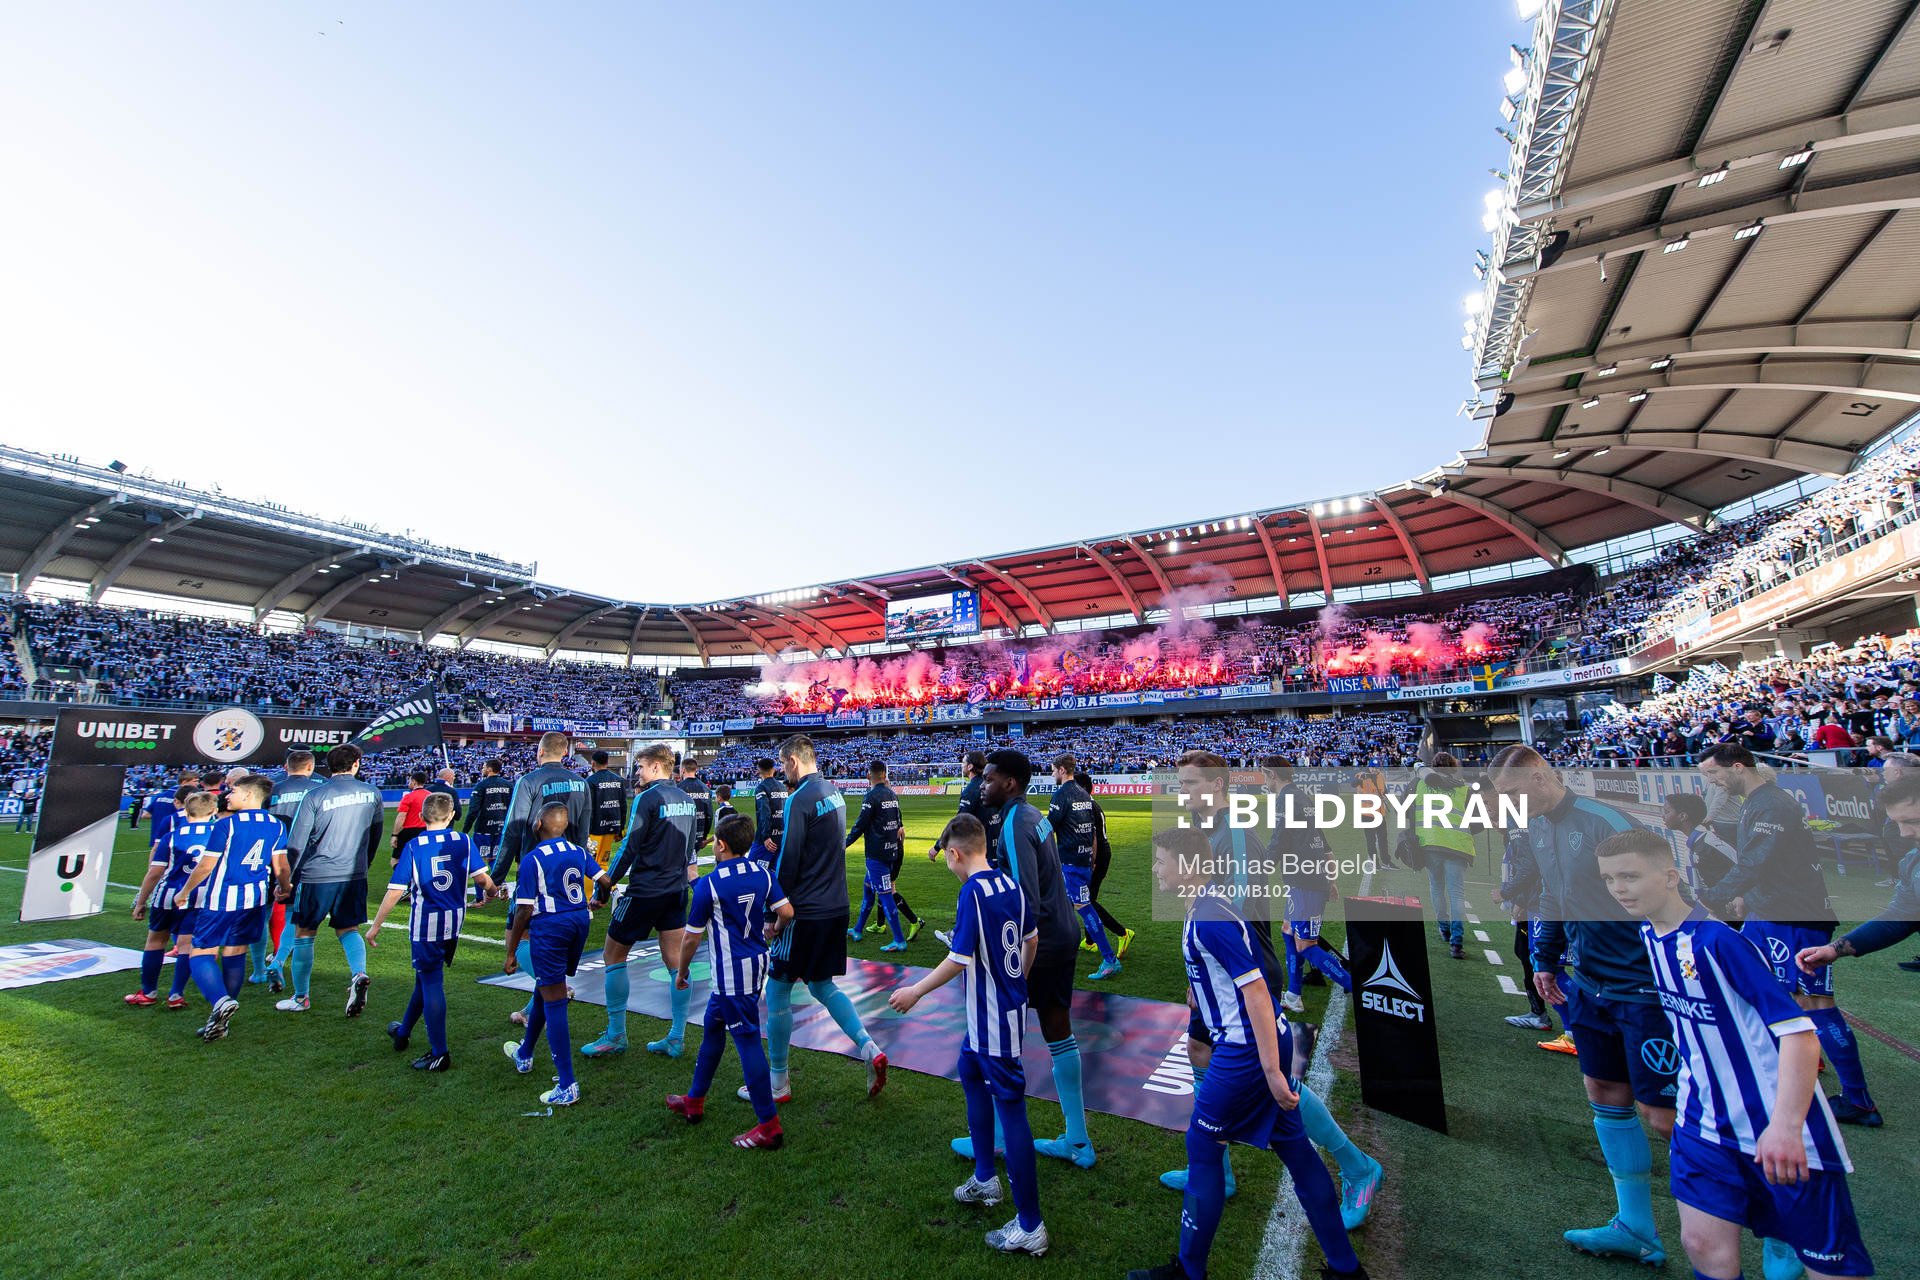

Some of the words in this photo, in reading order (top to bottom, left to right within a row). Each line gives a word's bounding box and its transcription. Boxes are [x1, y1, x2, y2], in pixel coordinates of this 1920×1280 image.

[1841, 402, 1882, 417] L2
[1727, 468, 1760, 481] L1
[1472, 548, 1491, 558] J1
[1364, 567, 1383, 576] J2
[177, 579, 204, 589] F4
[368, 609, 388, 617] F3
[1328, 677, 1361, 693] WISE
[1371, 676, 1400, 690] MEN
[1403, 684, 1472, 698] merinfo.se
[77, 721, 176, 740] UNIBET
[279, 728, 353, 744] UNIBET
[1094, 786, 1152, 794] BAUHAUS
[1825, 794, 1870, 820] Gamla
[1755, 821, 1785, 832] morris
[183, 844, 207, 874] 3
[241, 838, 265, 872] 4
[56, 853, 86, 880] U
[431, 854, 453, 892] 5
[562, 867, 583, 904] 6
[737, 892, 756, 940] 7
[1001, 920, 1022, 978] 8
[1361, 990, 1425, 1023] SELECT
[1197, 1118, 1220, 1133] CRAFT
[1802, 1248, 1838, 1262] CRAFT
